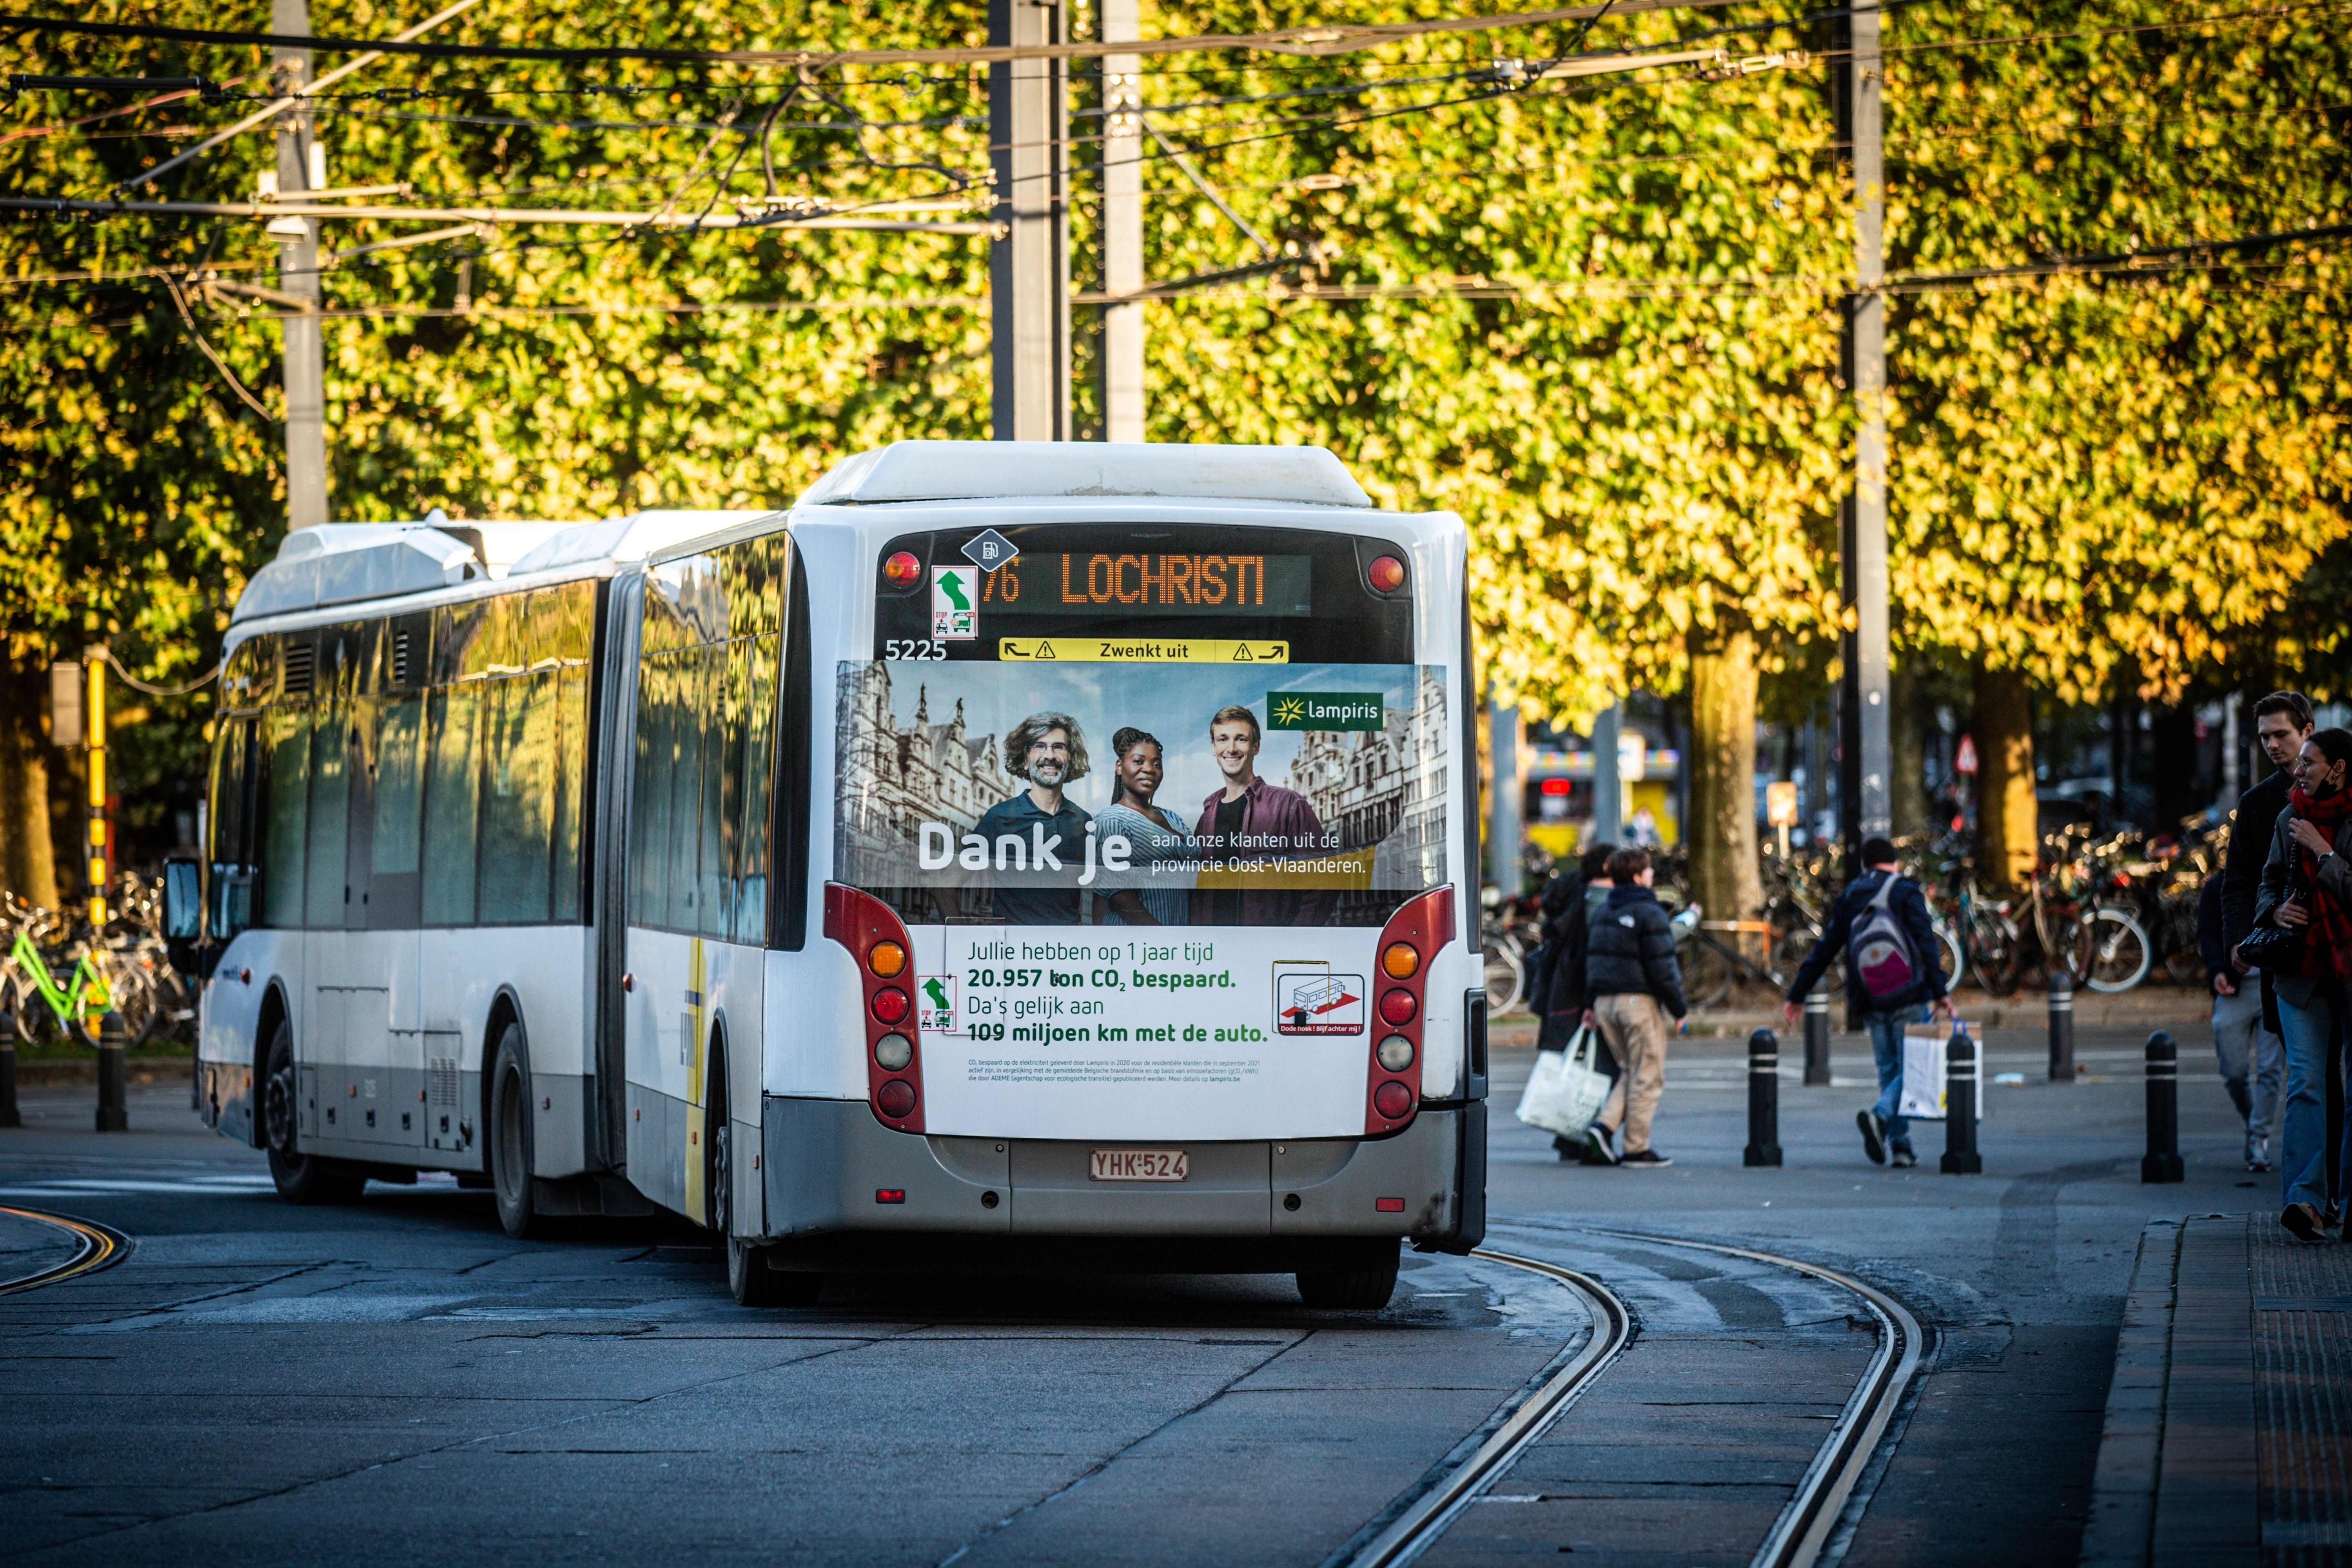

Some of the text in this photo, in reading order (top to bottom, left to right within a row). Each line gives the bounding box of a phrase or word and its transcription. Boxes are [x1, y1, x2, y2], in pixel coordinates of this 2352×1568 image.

[1063, 554, 1263, 604] LOCHRISTI
[885, 639, 947, 661] 5225
[1101, 643, 1188, 657] Zwenkt uit
[1151, 831, 1339, 848] aan onze klanten uit de
[919, 820, 1132, 886] Dank je
[1152, 857, 1366, 876] provincie Oost-Vlaanderen.
[968, 942, 1212, 965] Jullie hebben op 1 jaar tijd
[968, 969, 1042, 987] 20.957
[1050, 969, 1083, 987] ton
[1133, 969, 1236, 992] bespaard.
[969, 996, 1103, 1019] Da's gelijk aan
[967, 1023, 1267, 1046] 109 miljoen km met de auto.
[1096, 1153, 1184, 1176] YHK-524
